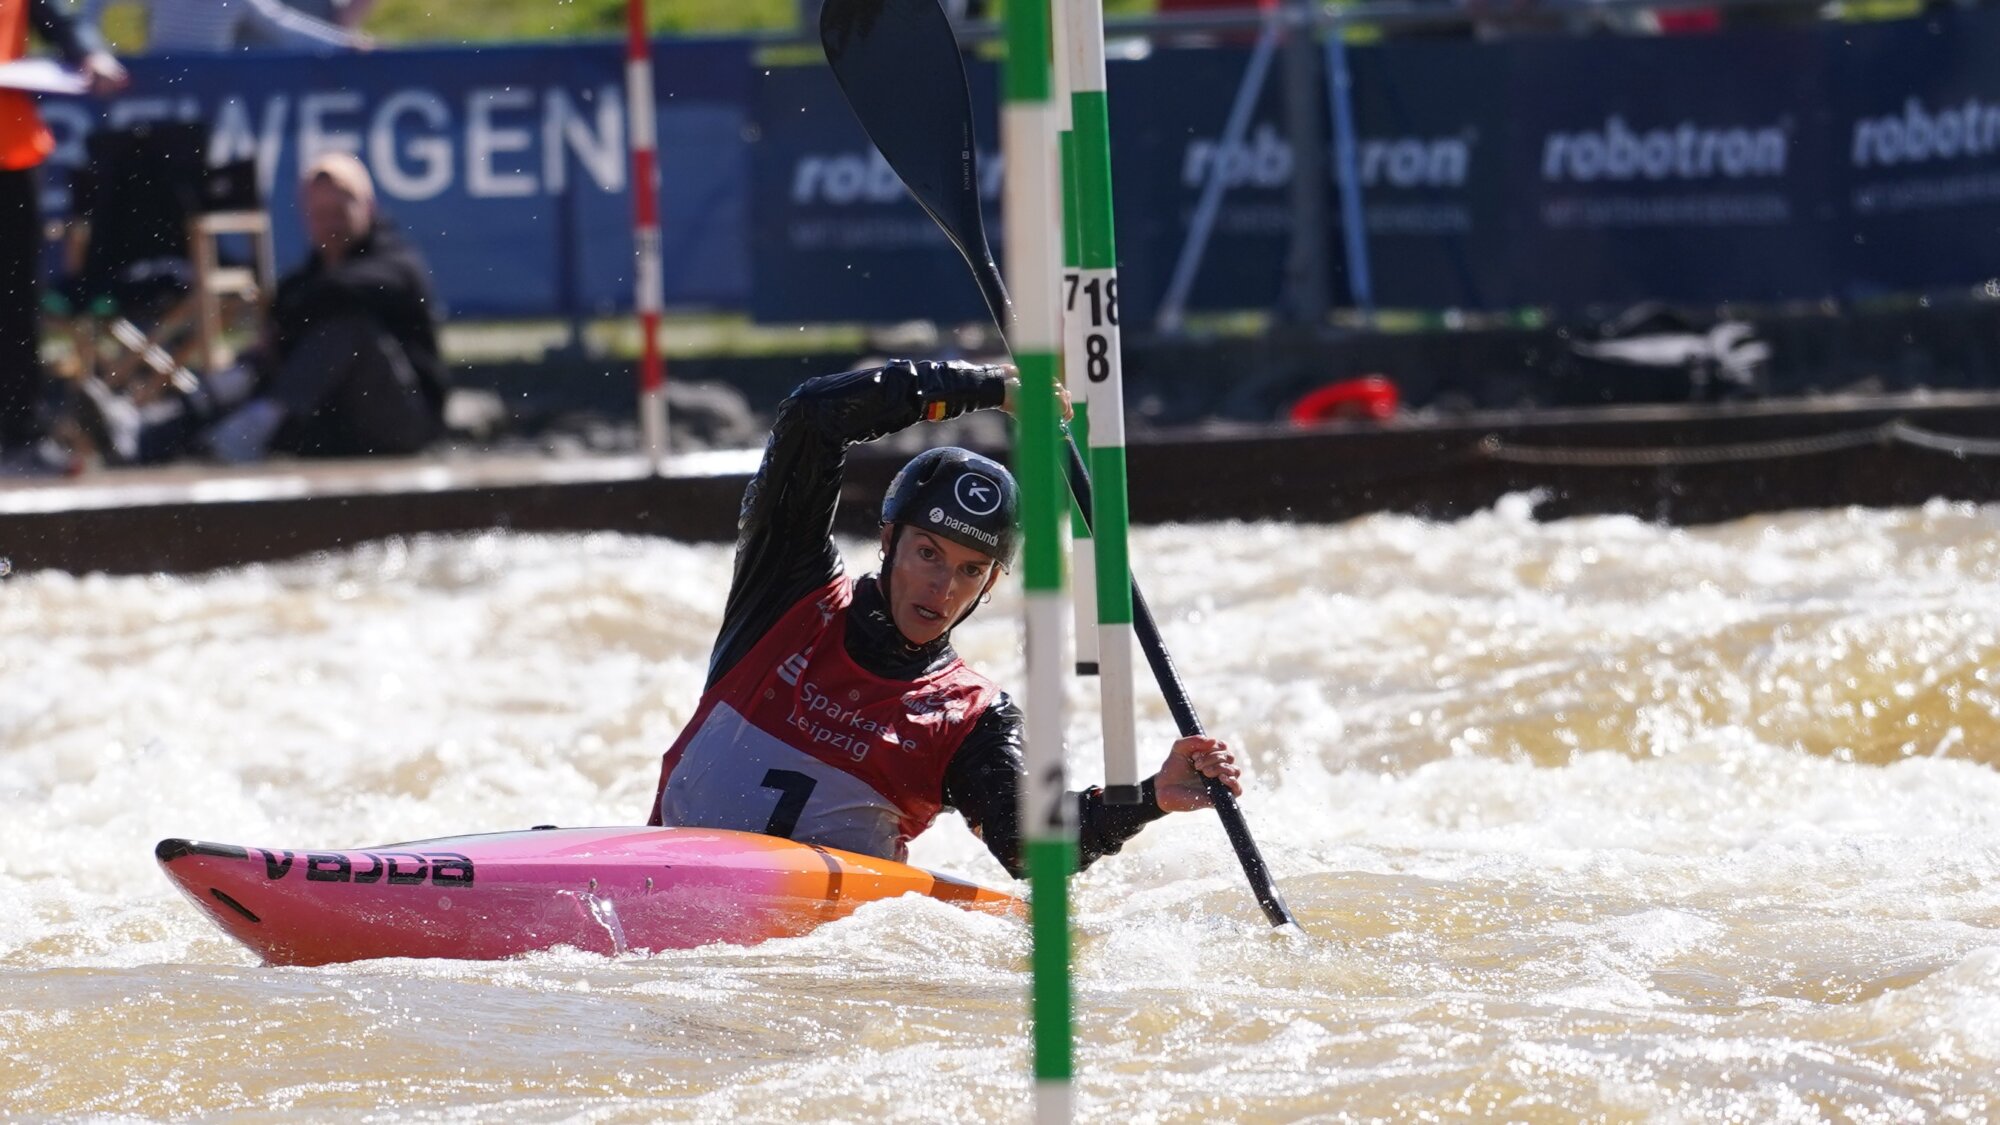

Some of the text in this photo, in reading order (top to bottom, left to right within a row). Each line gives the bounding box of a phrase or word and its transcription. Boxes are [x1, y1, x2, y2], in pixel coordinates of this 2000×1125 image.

[1542, 115, 1789, 182] robotron
[1086, 333, 1110, 384] 8
[944, 514, 999, 547] baramundi
[785, 703, 870, 762] Leipzig
[760, 768, 818, 840] 1
